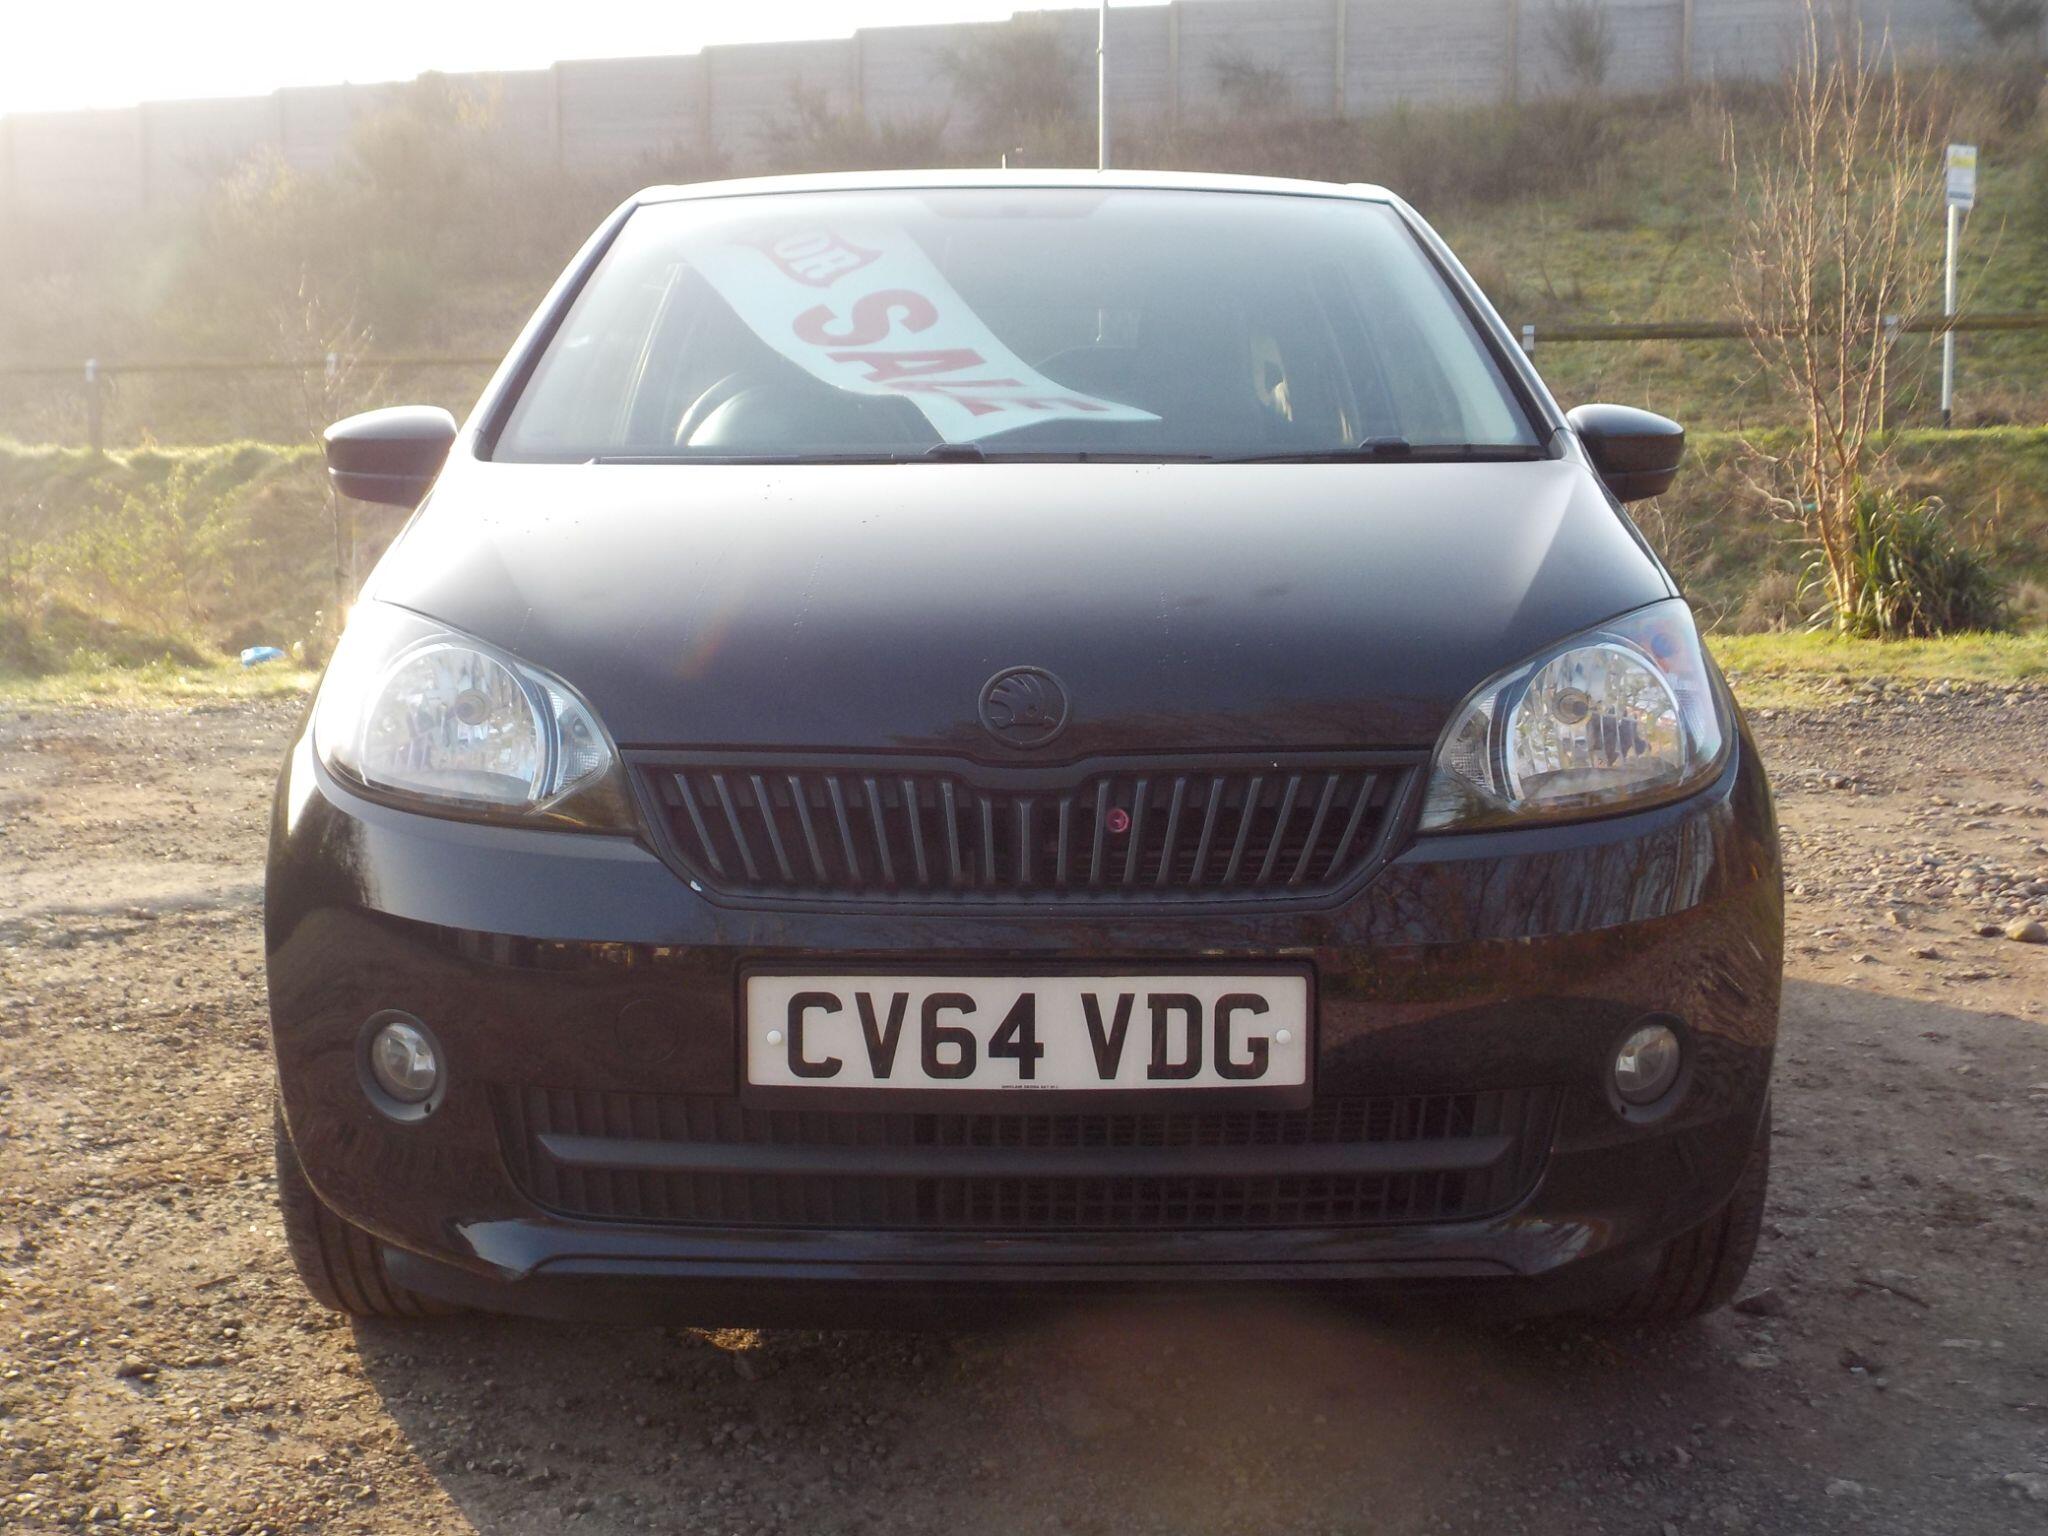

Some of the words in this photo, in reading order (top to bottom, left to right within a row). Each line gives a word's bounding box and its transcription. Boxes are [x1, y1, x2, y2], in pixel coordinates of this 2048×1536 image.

[793, 288, 1110, 416] SALE
[786, 991, 1044, 1079] CV64
[1080, 992, 1270, 1080] VDG
